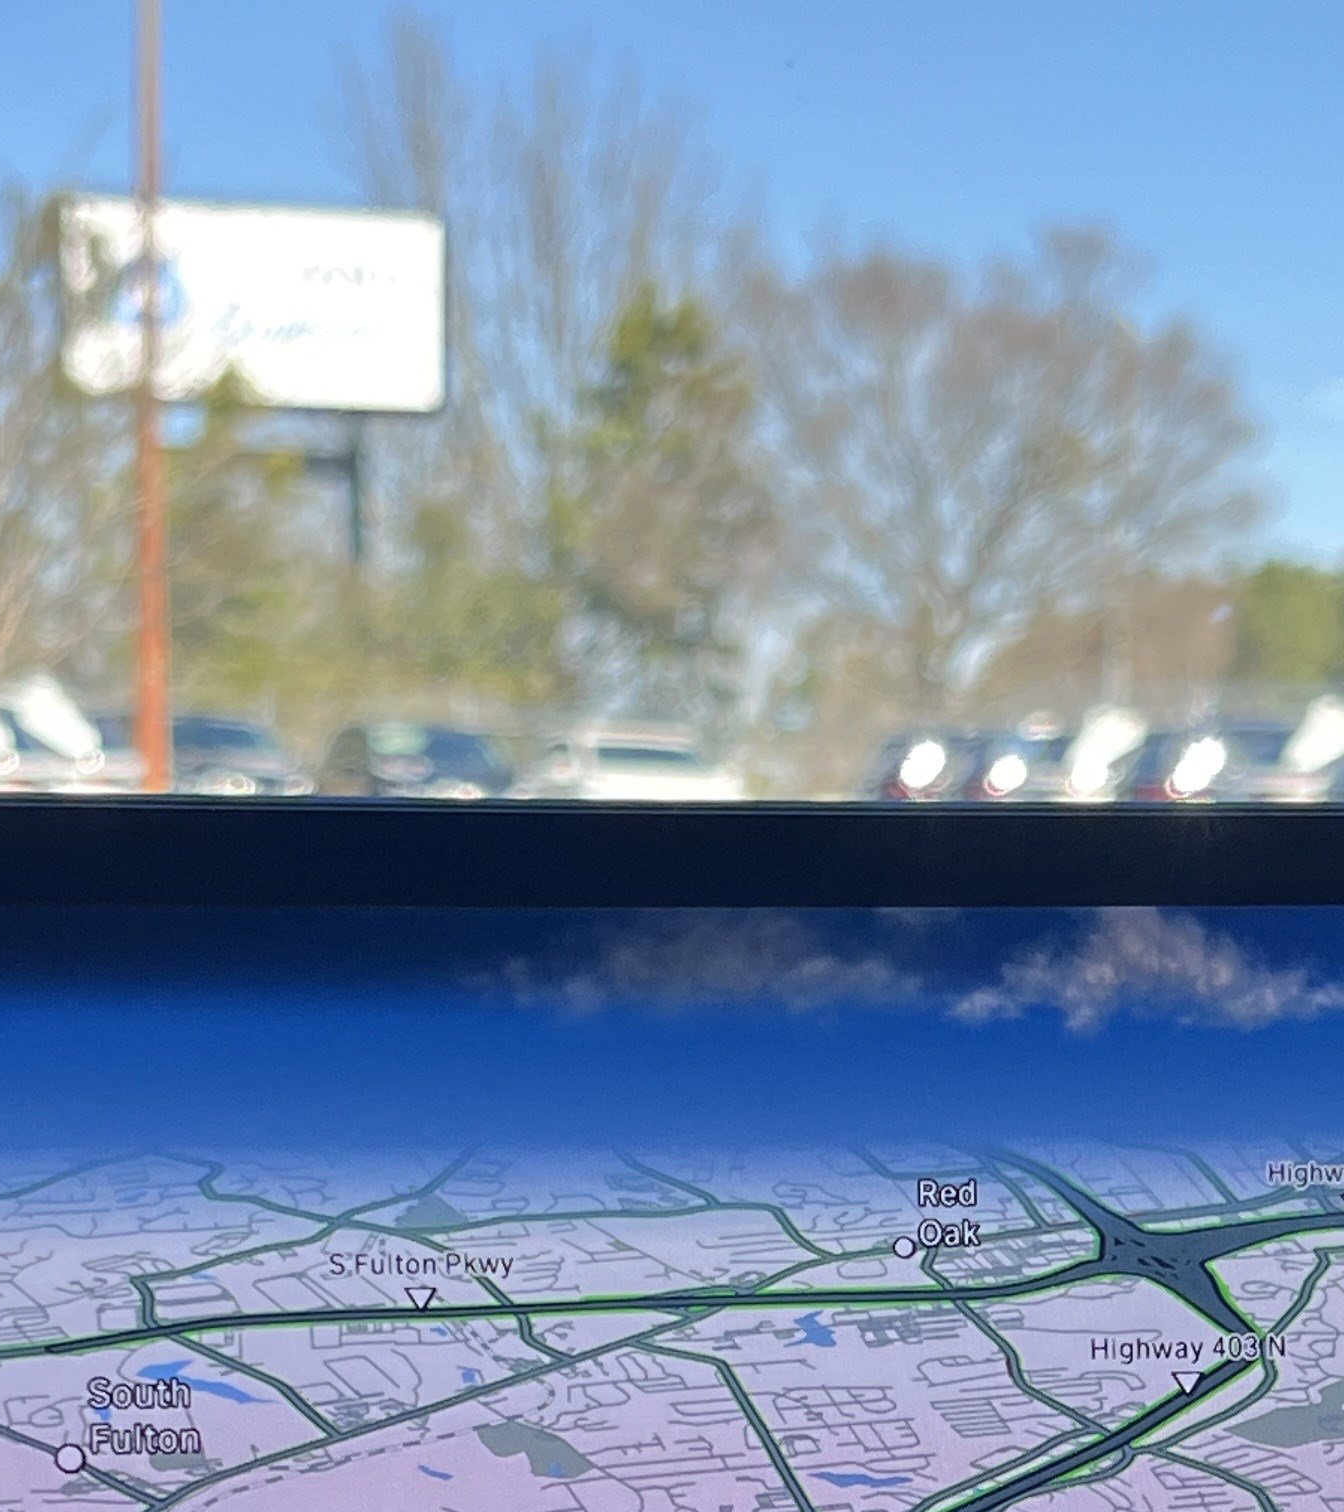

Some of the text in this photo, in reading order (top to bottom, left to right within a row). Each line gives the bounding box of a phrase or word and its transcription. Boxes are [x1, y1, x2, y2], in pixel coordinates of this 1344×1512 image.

[917, 1179, 978, 1209] Red
[918, 1218, 981, 1249] Oak
[329, 1250, 514, 1279] S Fulton Pkwy
[1090, 1336, 1287, 1364] Highway 403 N
[86, 1376, 192, 1410] South
[89, 1424, 201, 1456] Fulton
